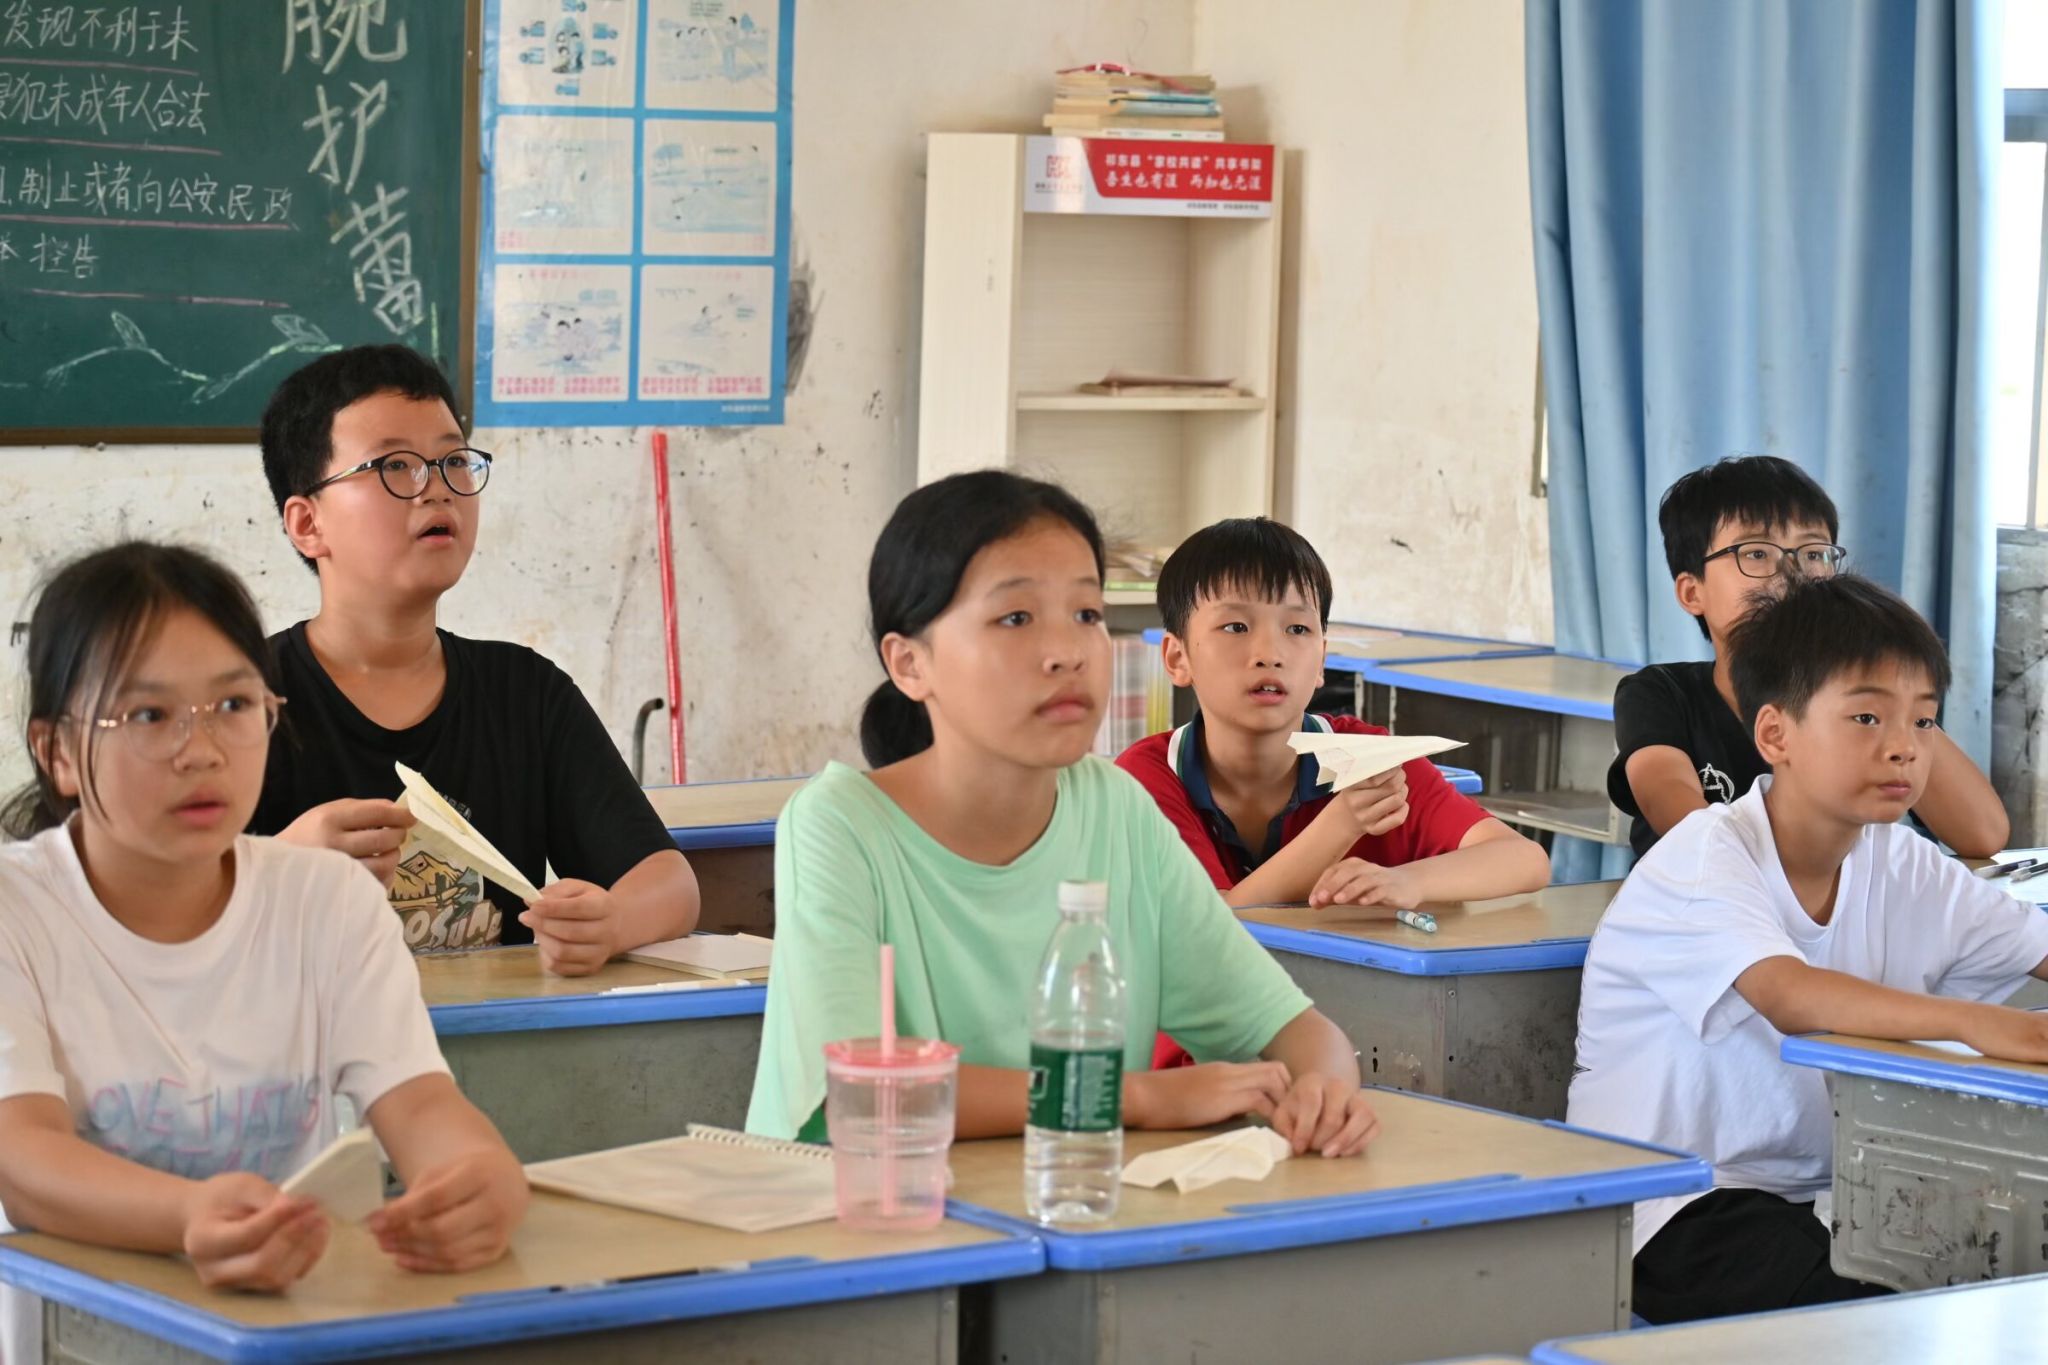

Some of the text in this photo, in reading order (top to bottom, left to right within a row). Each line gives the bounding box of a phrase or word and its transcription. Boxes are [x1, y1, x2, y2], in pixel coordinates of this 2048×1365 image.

[3, 2, 199, 61] 发现不利于未
